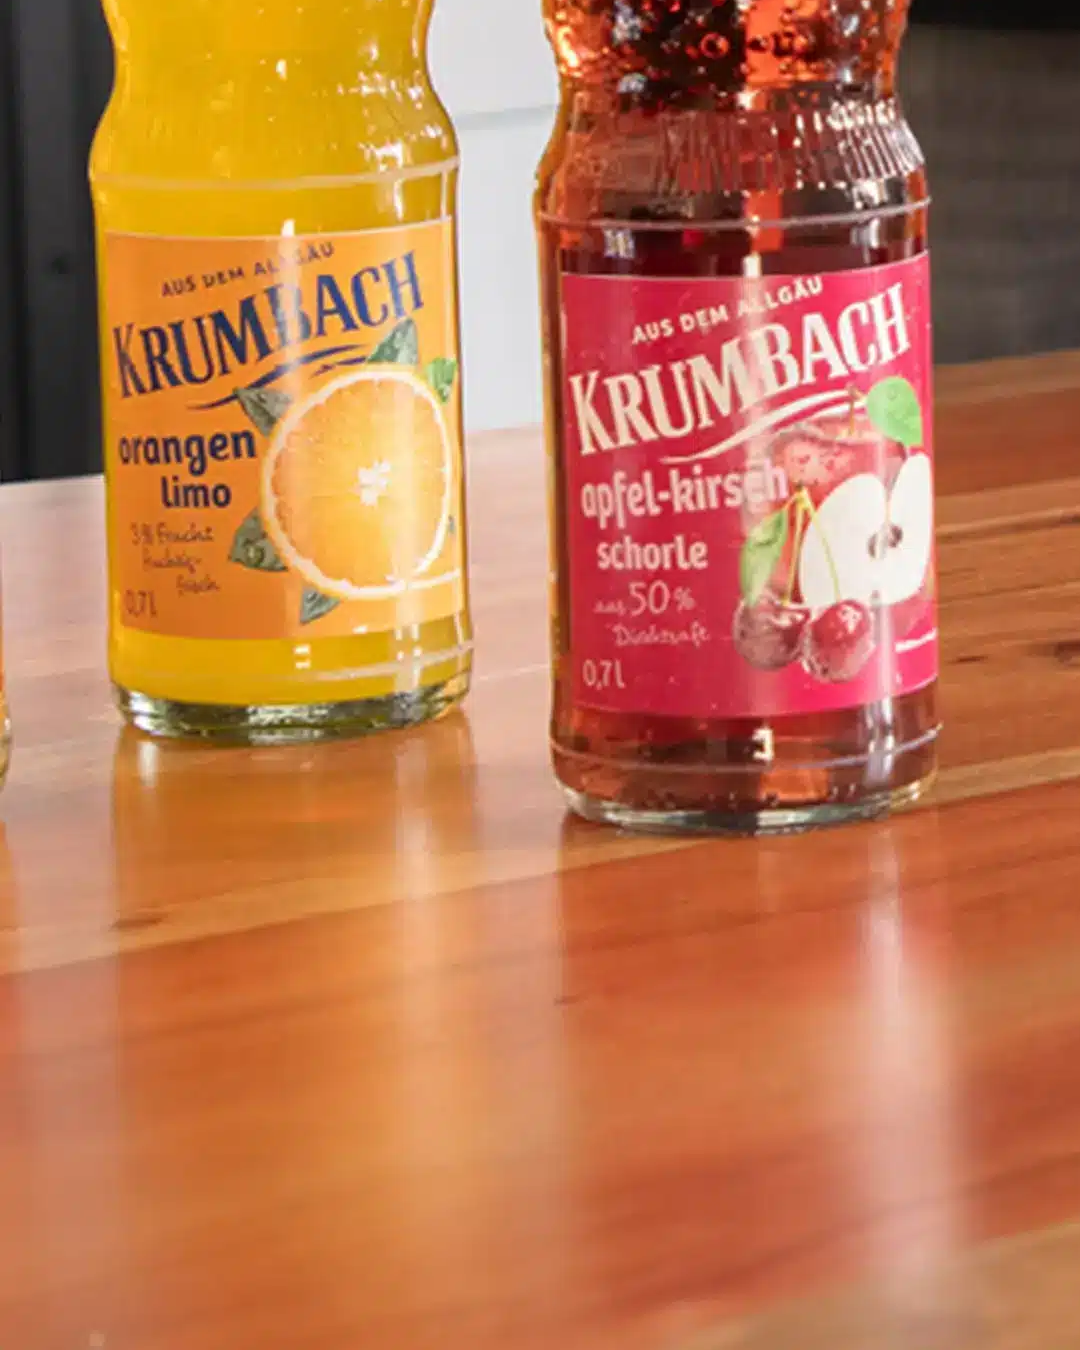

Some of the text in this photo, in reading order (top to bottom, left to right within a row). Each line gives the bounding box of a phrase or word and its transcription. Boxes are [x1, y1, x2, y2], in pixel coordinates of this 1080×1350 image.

[160, 273, 197, 298] AUS
[202, 267, 245, 288] DEM
[112, 250, 425, 399] KRUMBACH
[631, 318, 675, 345] AUS
[679, 303, 729, 334] DEM
[568, 282, 912, 457] KRUMBACH
[119, 428, 257, 476] orangen
[160, 476, 232, 510] limo
[580, 457, 789, 531] apfel-kirsch
[596, 534, 709, 571] schorle
